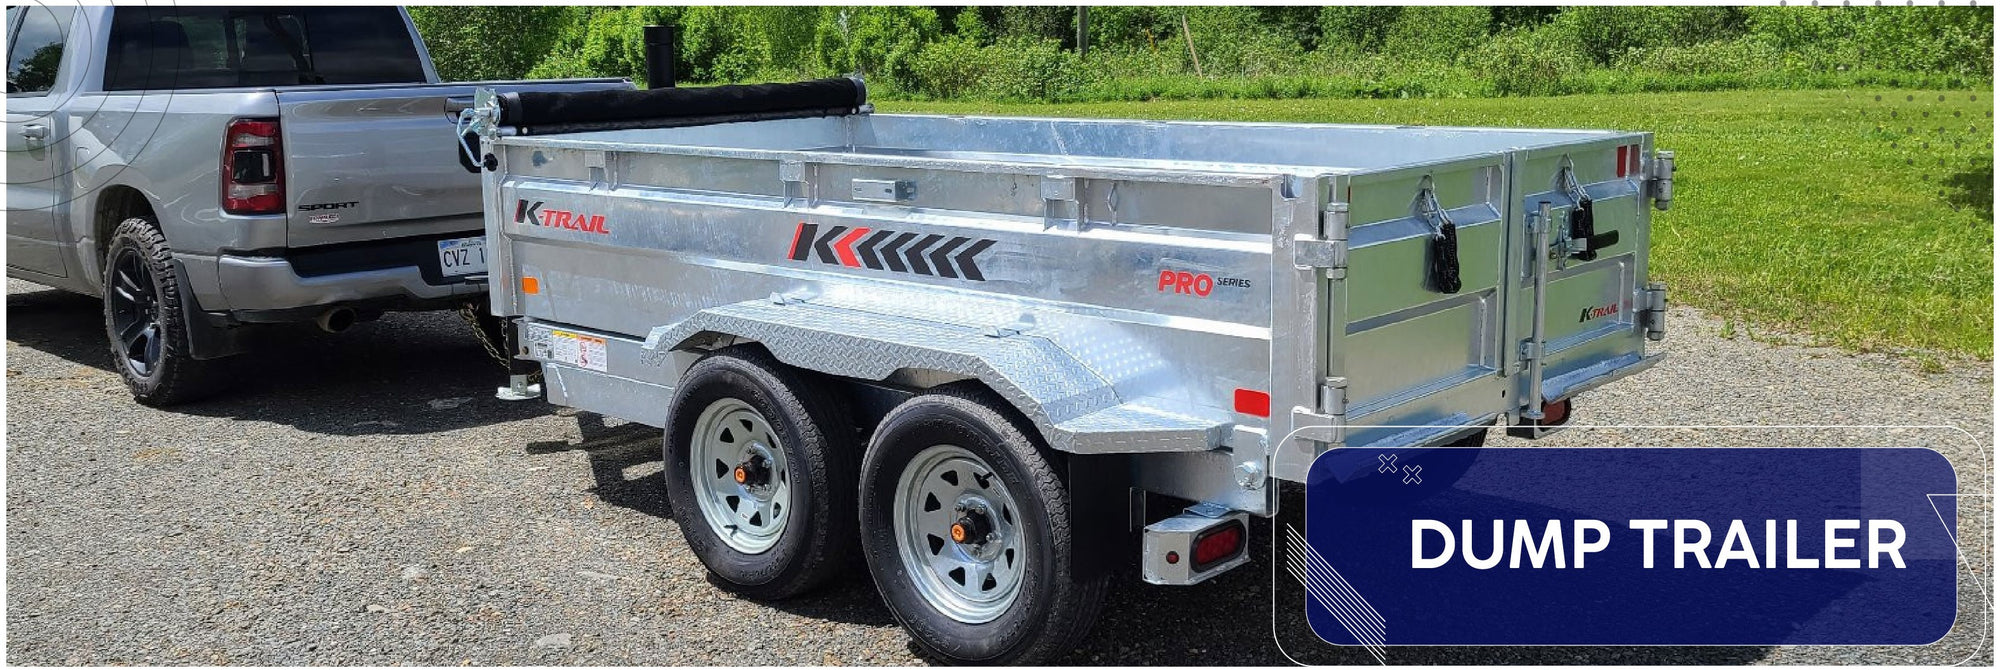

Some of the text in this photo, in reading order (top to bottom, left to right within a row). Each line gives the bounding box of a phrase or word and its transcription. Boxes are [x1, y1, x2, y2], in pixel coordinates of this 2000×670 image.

[298, 201, 360, 211] SPORT
[514, 199, 609, 234] K-TRAIL
[443, 249, 470, 267] CVZ
[1158, 269, 1251, 297] PRO SERIES
